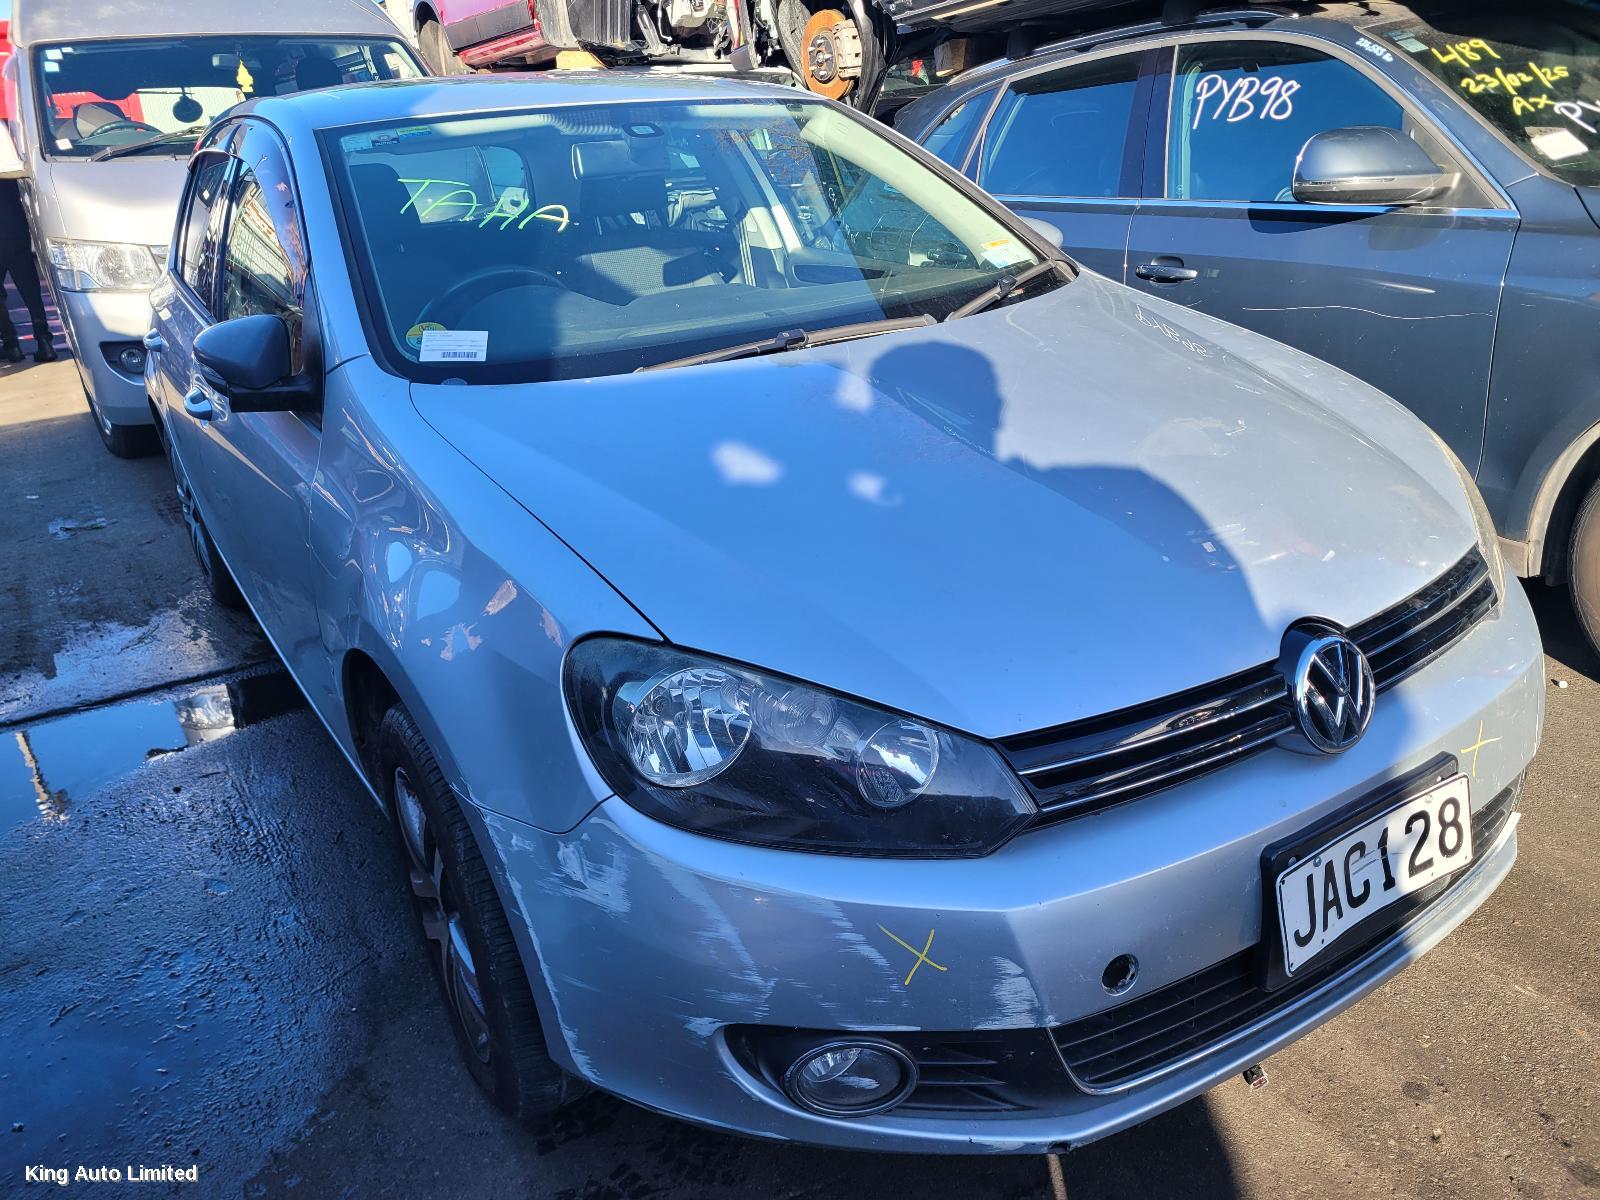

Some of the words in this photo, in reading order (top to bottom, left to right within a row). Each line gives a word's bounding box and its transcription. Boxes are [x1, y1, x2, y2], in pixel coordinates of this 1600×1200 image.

[1431, 39, 1502, 68] 489
[1460, 61, 1569, 95] 23/02/25
[1192, 74, 1301, 130] PYB98
[1297, 638, 1373, 748] VW
[1293, 796, 1465, 948] JAC128
